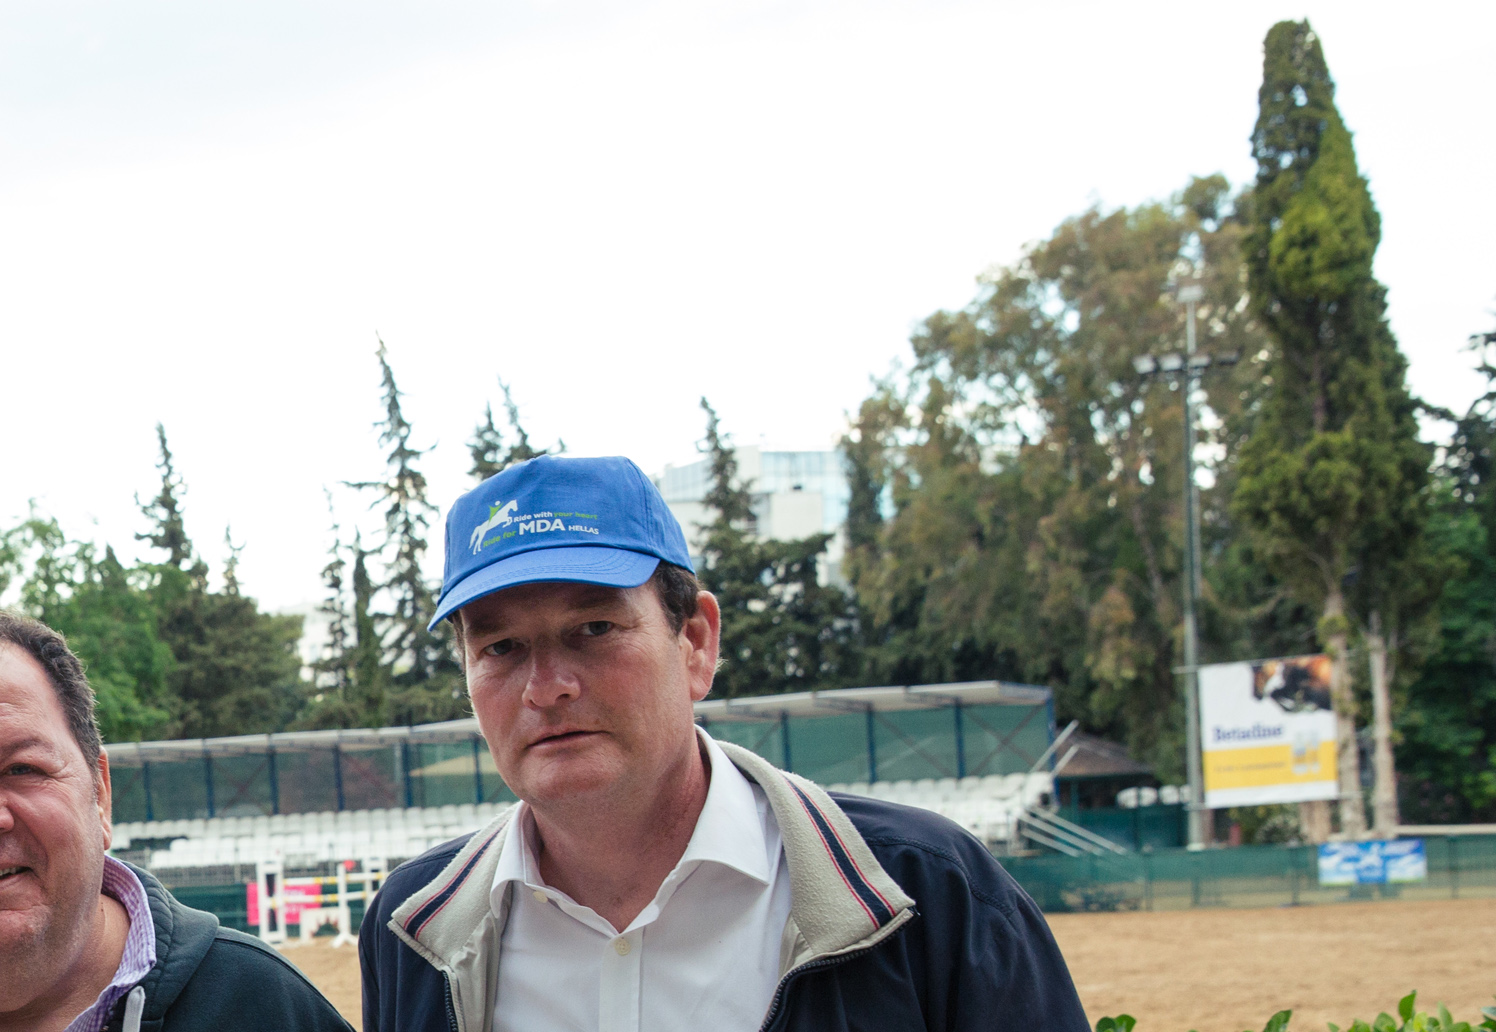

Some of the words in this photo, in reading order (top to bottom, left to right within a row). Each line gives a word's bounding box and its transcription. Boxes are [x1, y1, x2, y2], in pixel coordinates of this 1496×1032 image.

[503, 530, 517, 539] for
[519, 518, 566, 536] MDA
[568, 525, 600, 535] HELLAS
